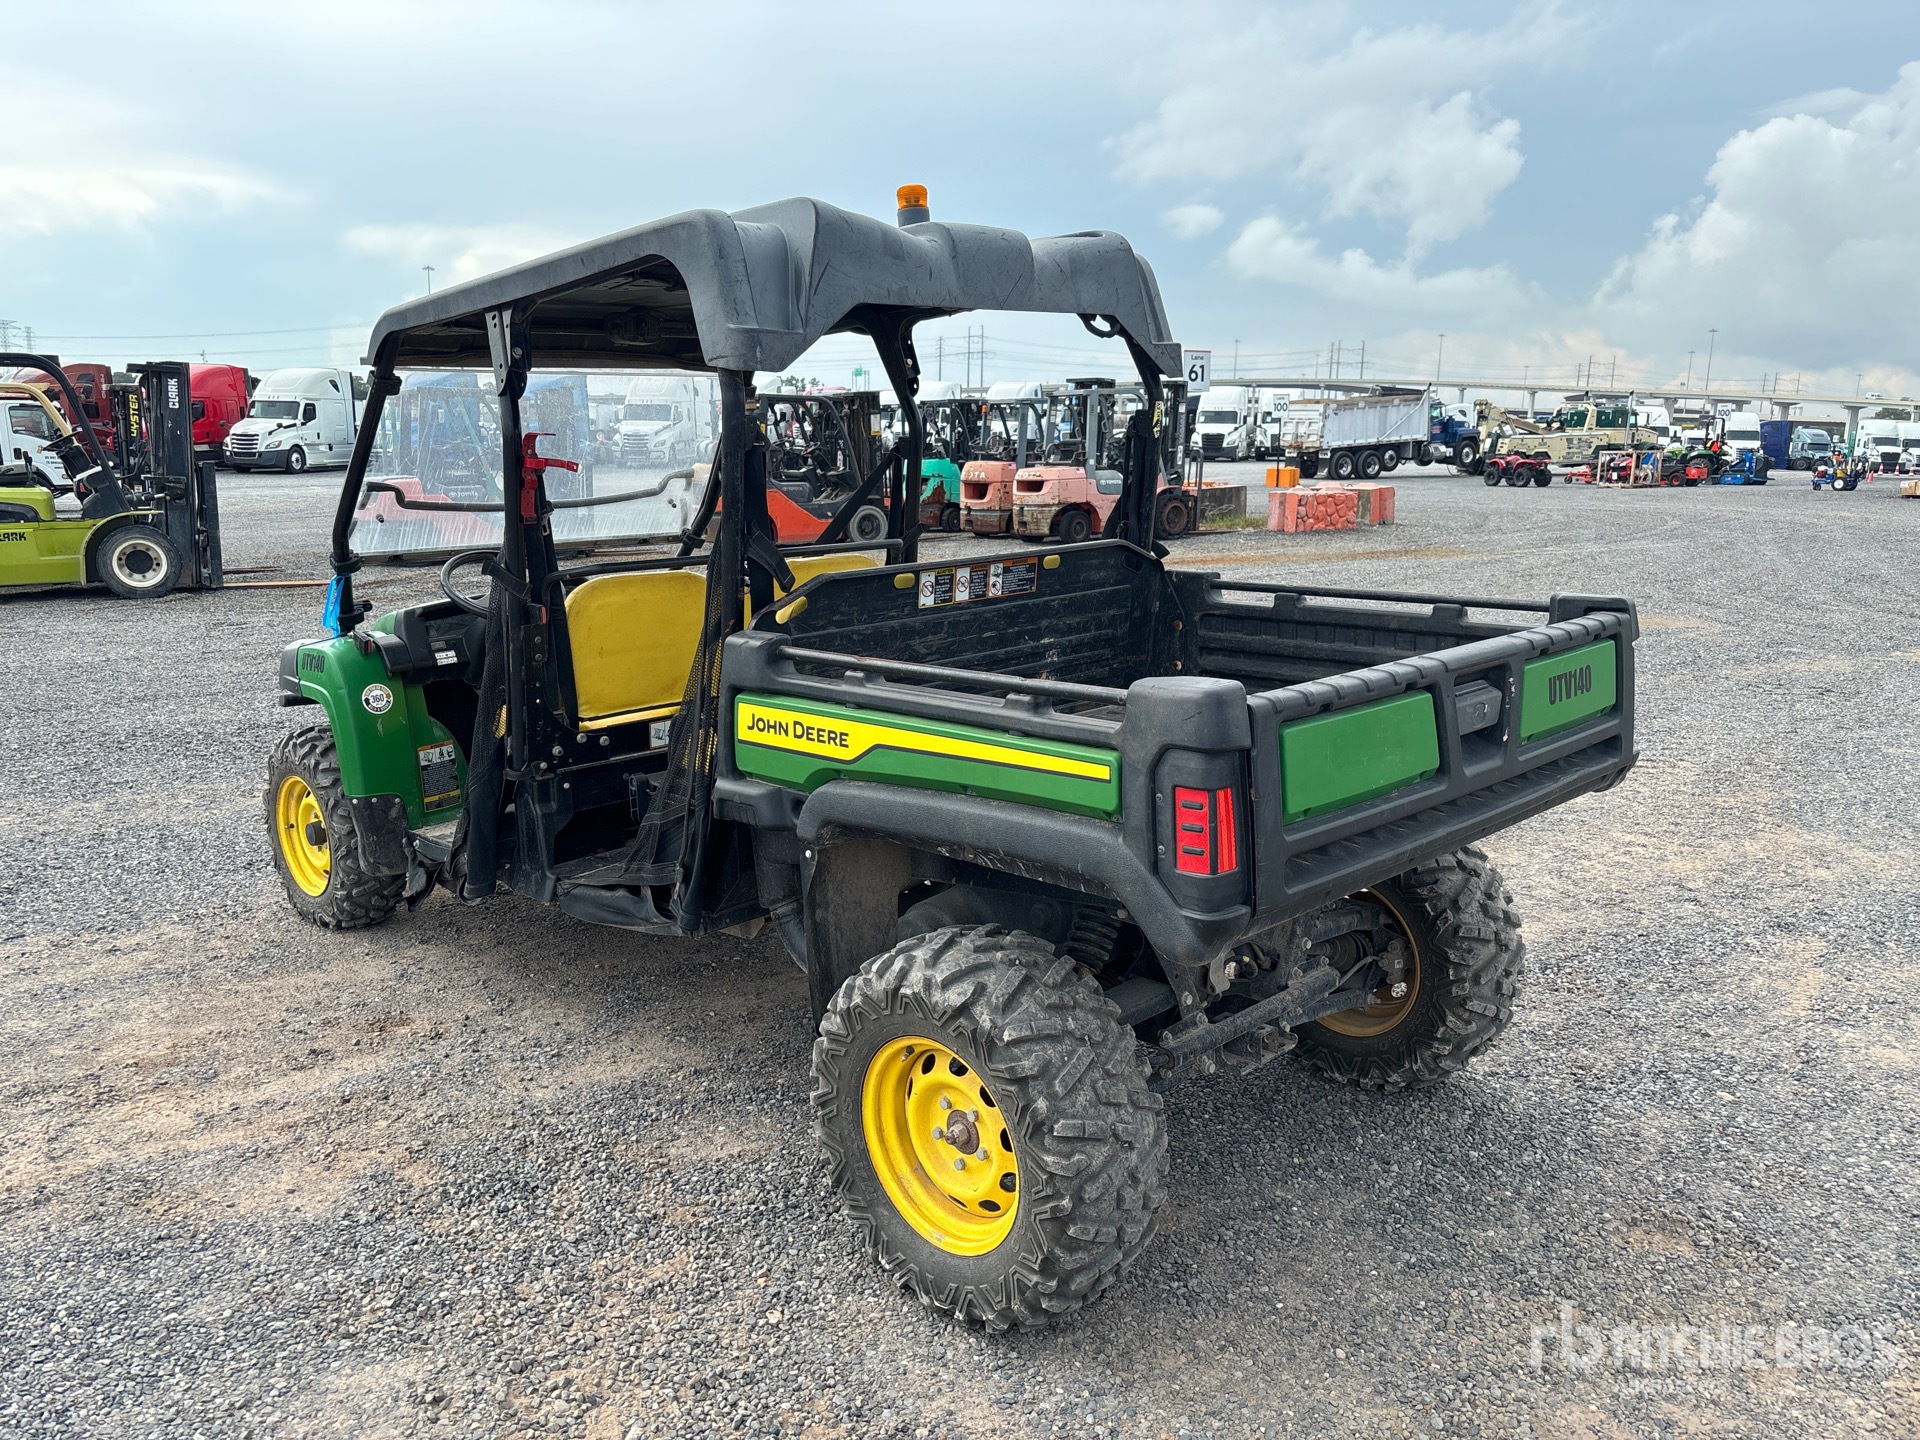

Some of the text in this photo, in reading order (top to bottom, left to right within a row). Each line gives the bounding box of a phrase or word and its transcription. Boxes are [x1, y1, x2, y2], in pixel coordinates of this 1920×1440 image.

[1188, 364, 1205, 382] 61
[167, 378, 179, 409] CLARK
[1273, 402, 1288, 412] 100
[1717, 408, 1731, 417] 100
[302, 652, 325, 674] UTV140
[1548, 664, 1592, 706] UTV140
[370, 693, 384, 704] 360
[747, 713, 849, 748] JOHN DEERE
